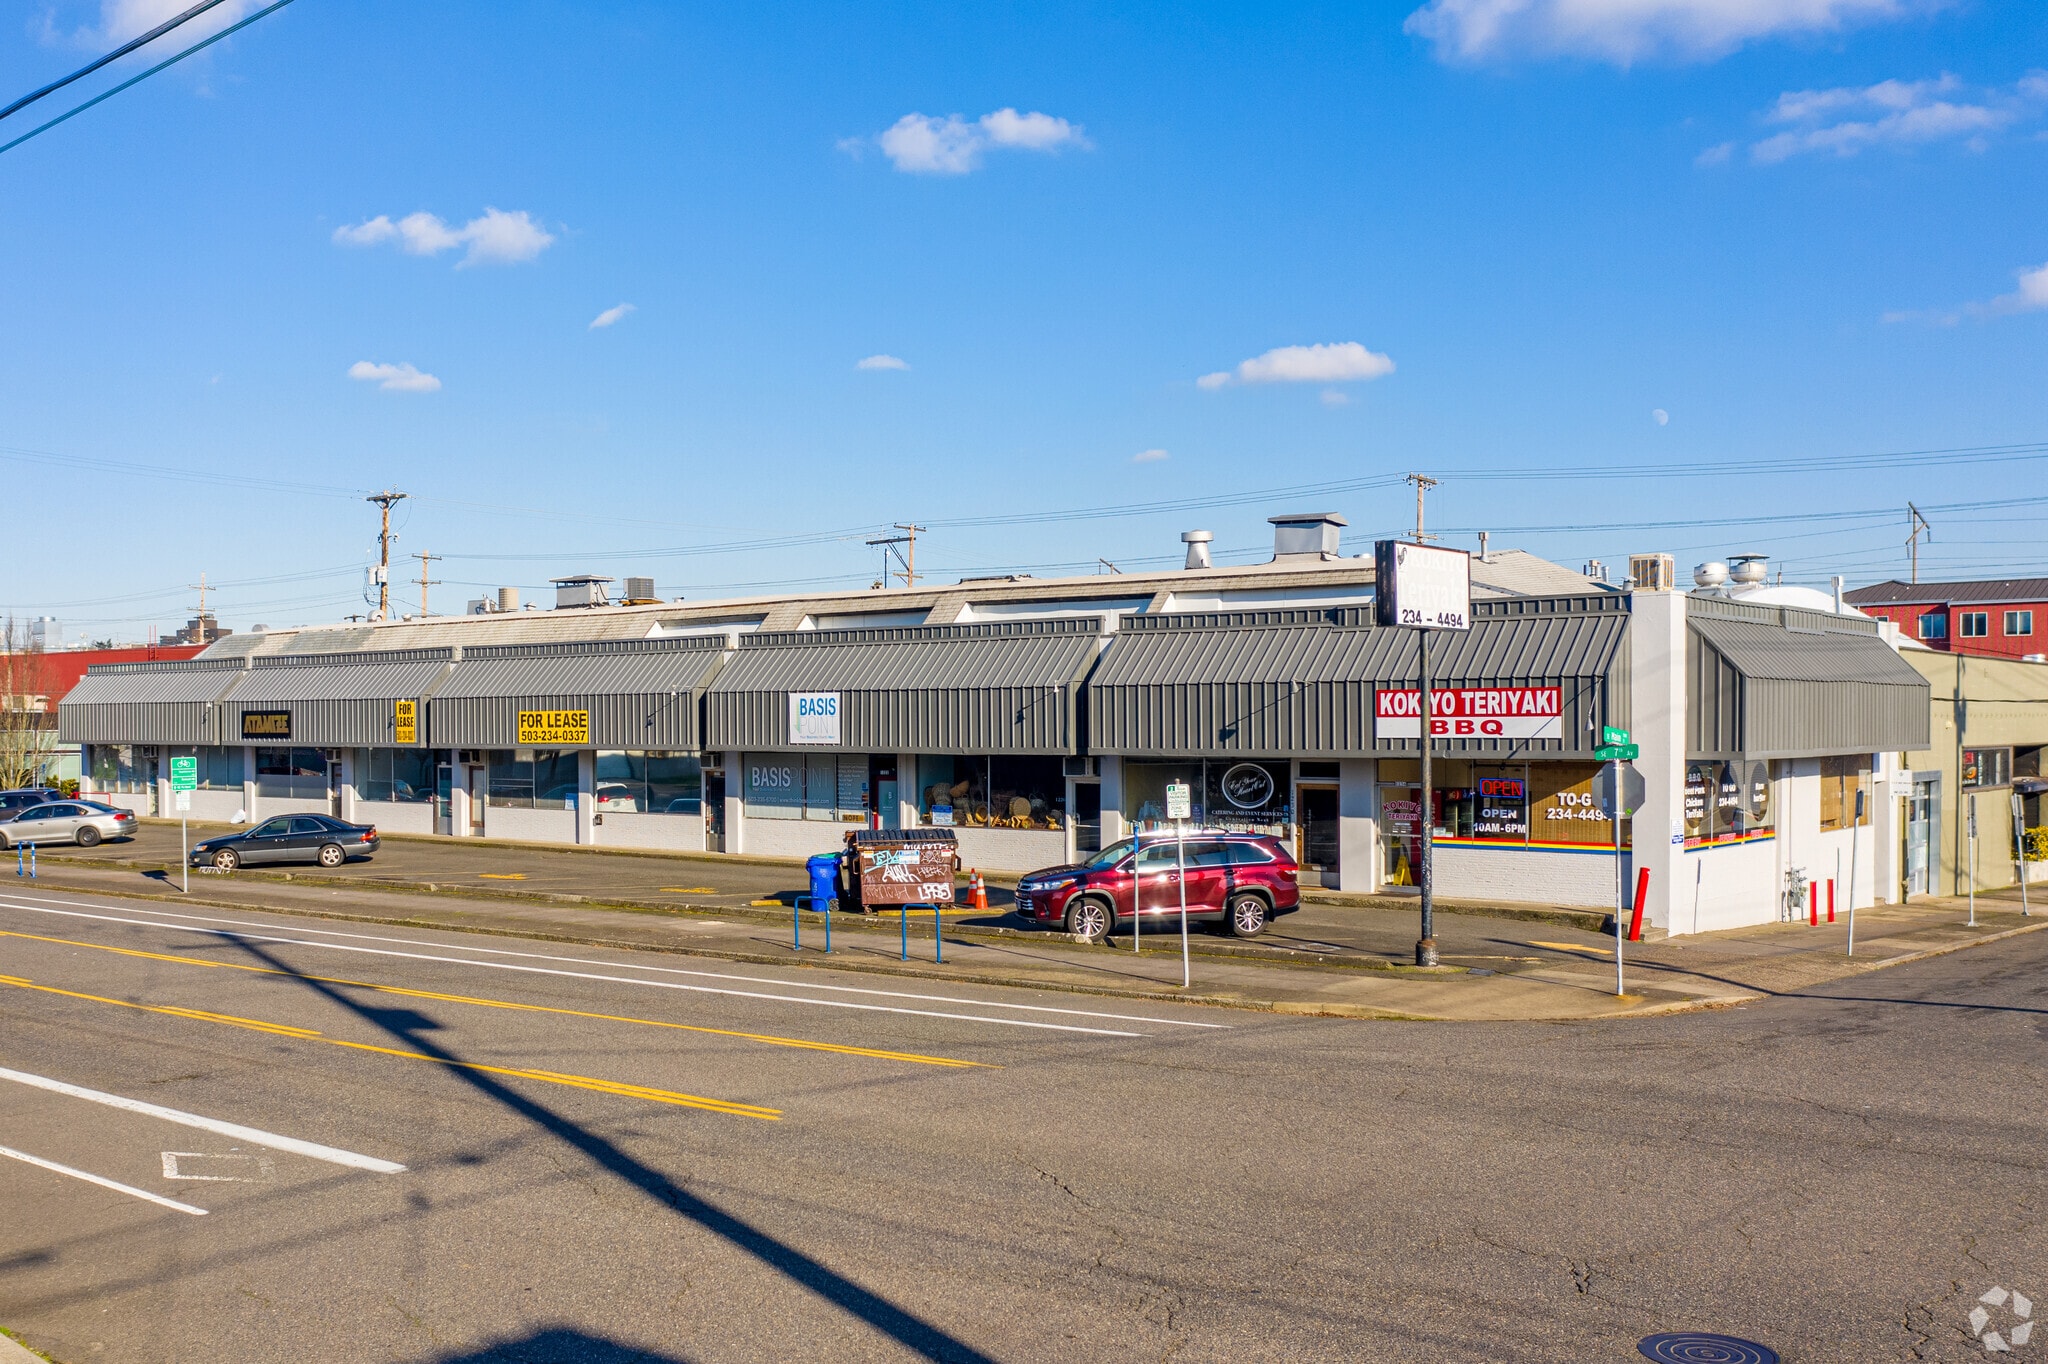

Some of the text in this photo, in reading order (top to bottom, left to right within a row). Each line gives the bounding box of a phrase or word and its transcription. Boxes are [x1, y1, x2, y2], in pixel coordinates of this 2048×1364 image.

[1402, 608, 1422, 624] 234
[1437, 612, 1463, 628] 4494
[398, 703, 412, 715] FOR
[799, 698, 836, 716] BASIS
[1379, 690, 1558, 715] KOKYO TERIYAKI
[397, 716, 414, 728] LEASE
[520, 713, 587, 728] FOR LEASE
[800, 716, 837, 735] POINT
[1430, 719, 1504, 736] BBQ
[521, 730, 587, 741] 503-234-0337
[1600, 750, 1607, 758] SE
[752, 766, 791, 787] BASIS
[1481, 779, 1523, 797] OPEN
[1382, 800, 1422, 814] KOKIYO
[1556, 792, 1592, 807] TO-G
[1685, 797, 1704, 808] Chicken
[1387, 812, 1418, 821] TERIYAKI
[1482, 808, 1518, 820] OPEN
[1547, 807, 1612, 822] 234-449
[1473, 822, 1527, 834] 10AM-6PM
